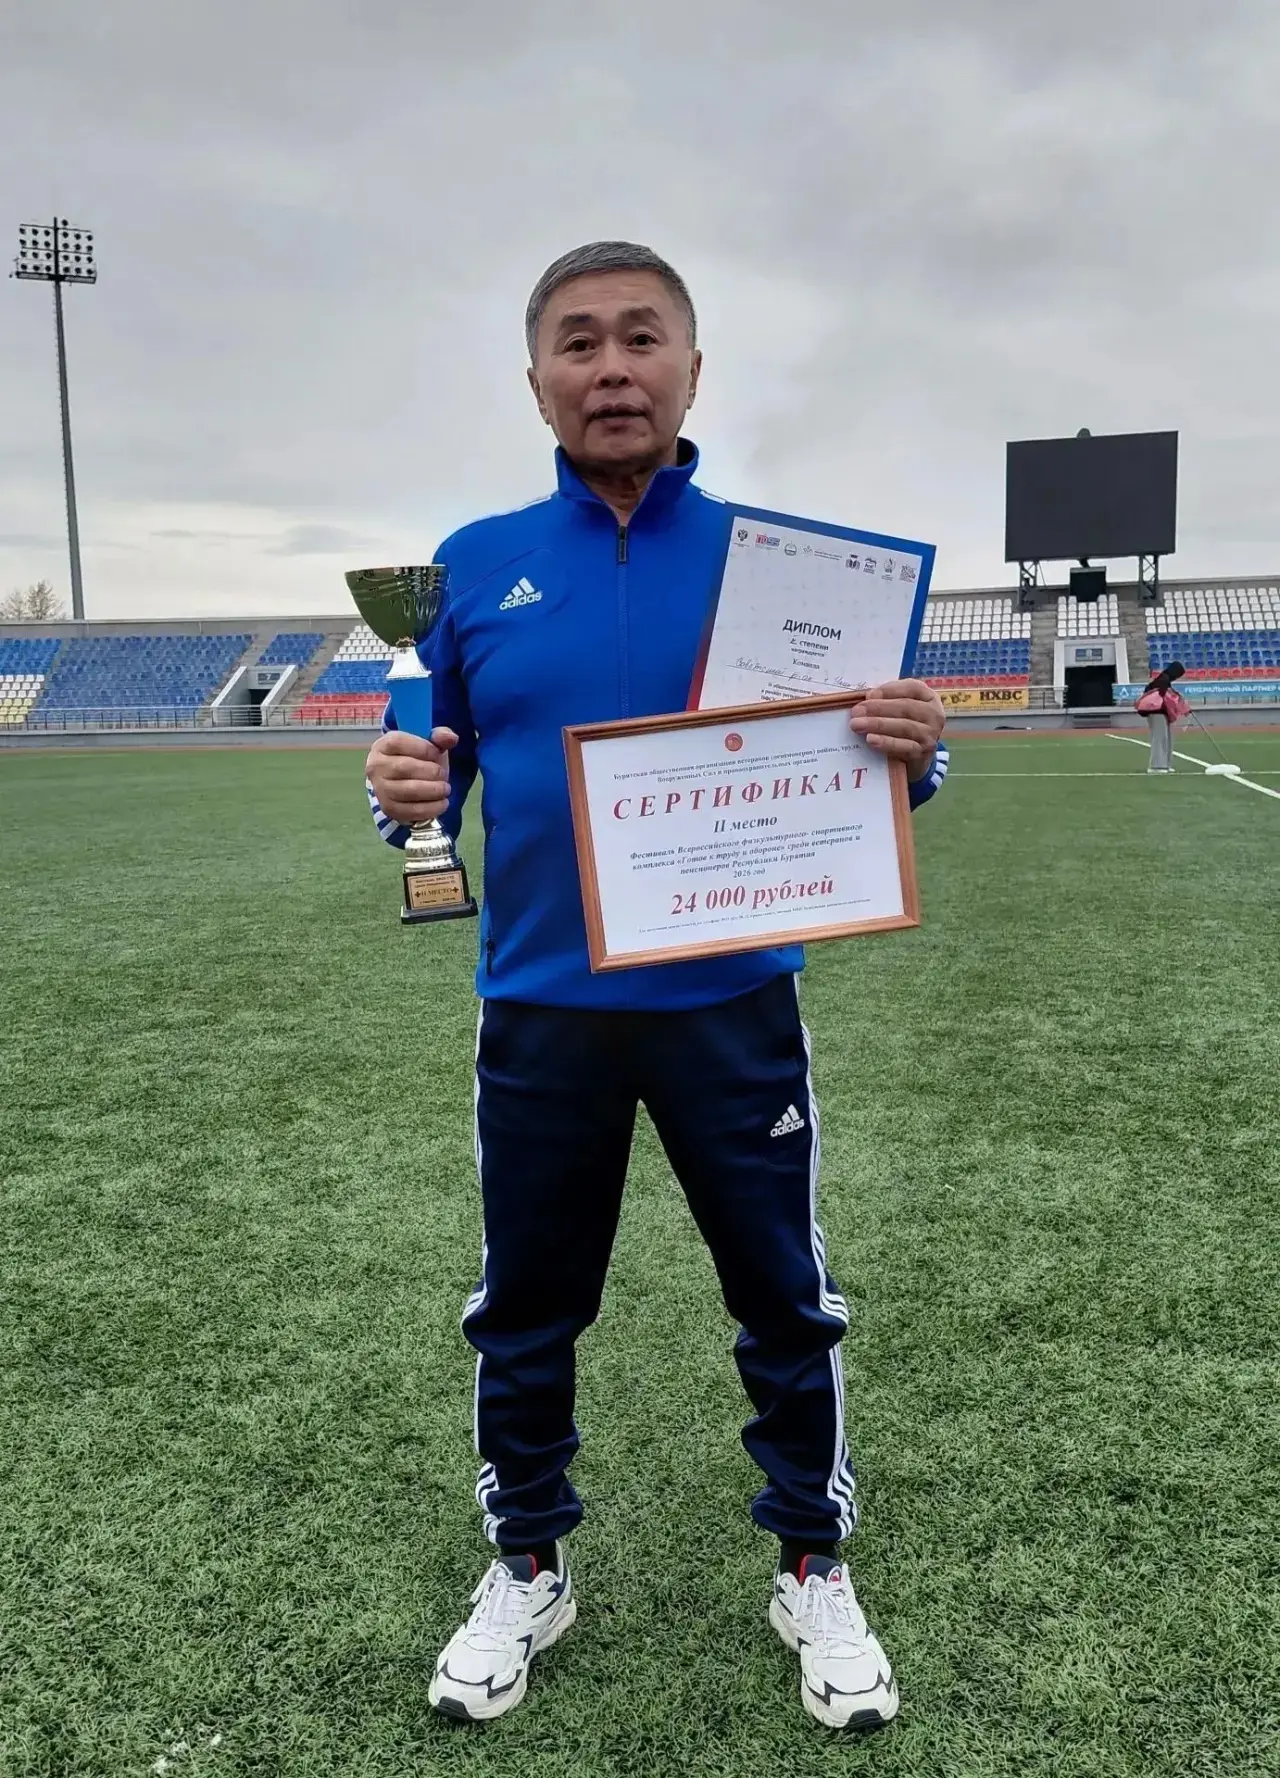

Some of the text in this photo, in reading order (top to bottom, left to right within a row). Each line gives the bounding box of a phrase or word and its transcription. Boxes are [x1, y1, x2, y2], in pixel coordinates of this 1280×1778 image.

[499, 590, 543, 610] adidas
[782, 618, 842, 641] ДИПЛОМ
[799, 640, 829, 651] степени
[1184, 685, 1241, 694] ГЕНЕРАЛЬНЫЙ
[1242, 685, 1277, 693] ПАРТНЕР
[613, 771, 648, 781] Бурятская
[649, 765, 695, 776] общественная
[695, 759, 736, 771] организация
[737, 755, 769, 766] ветеранов
[770, 749, 815, 760] (пенсионеров)
[657, 774, 701, 783] Вооруженных
[702, 769, 716, 778] Сил
[723, 762, 791, 777] правоохранительных
[613, 767, 868, 820] СЕРТИФИКАТ
[713, 816, 778, 833] II место
[630, 849, 675, 860] Фестиваль
[677, 840, 740, 854] Всероссийского
[811, 823, 863, 836] спортивного
[632, 860, 675, 870] комплекса
[676, 855, 707, 865] «Готов
[716, 850, 741, 860] труду
[749, 845, 785, 855] обороне»
[787, 840, 810, 850] среди
[811, 836, 853, 846] ветеранов
[680, 851, 816, 875] пенсионеров Республики Бурятия
[733, 867, 766, 878] 2026 год
[670, 890, 698, 915] 24
[705, 885, 746, 910] 000
[752, 875, 835, 909] рублей
[770, 1118, 805, 1137] adidas
